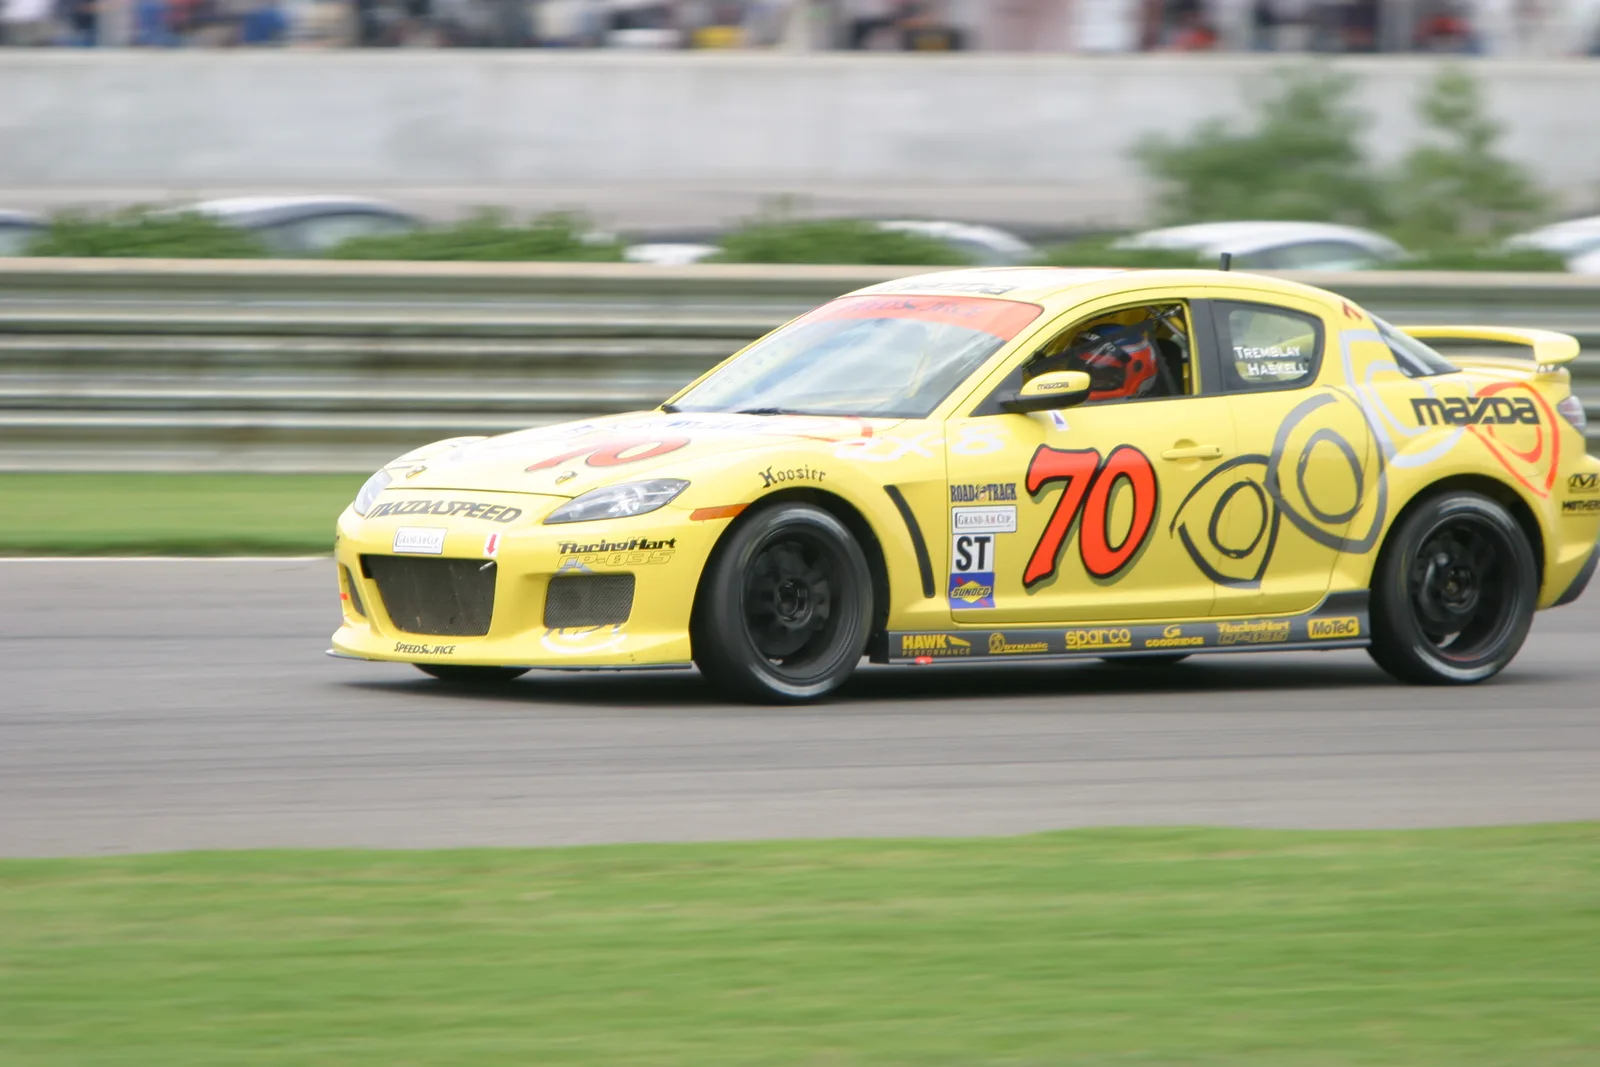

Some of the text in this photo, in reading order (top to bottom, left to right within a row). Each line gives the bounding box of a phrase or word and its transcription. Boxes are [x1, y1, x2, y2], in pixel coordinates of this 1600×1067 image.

[1233, 346, 1300, 359] TREMBLAY
[1248, 363, 1308, 376] HASKELL
[757, 464, 826, 488] Hoosier
[950, 484, 974, 502] ROAD
[988, 483, 1017, 501] TRACK
[1022, 443, 1159, 593] 70
[956, 535, 991, 571] ST
[952, 586, 991, 598] SUNOCO
[1311, 620, 1355, 636] MoTeC
[902, 634, 947, 649] HAWK
[1065, 628, 1131, 648] sparco
